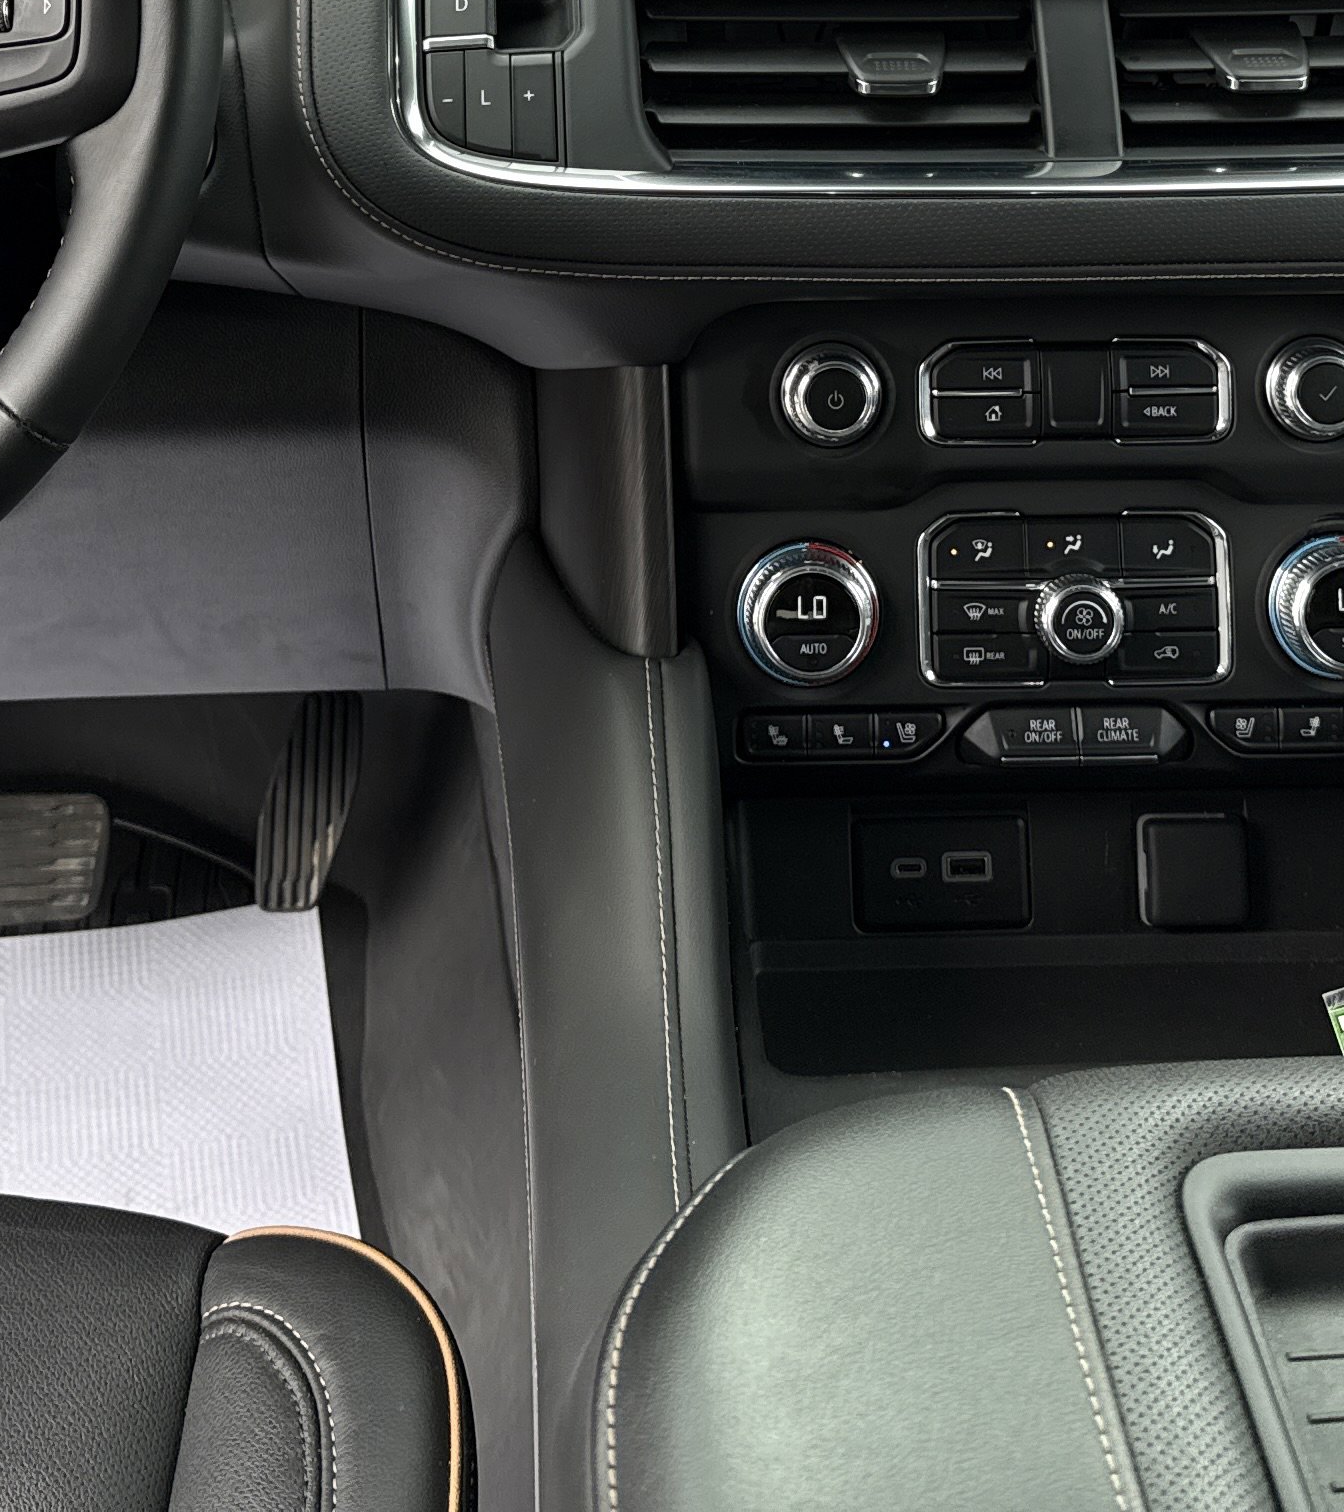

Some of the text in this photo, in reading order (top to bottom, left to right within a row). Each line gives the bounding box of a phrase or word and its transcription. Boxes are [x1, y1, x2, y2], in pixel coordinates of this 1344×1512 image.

[480, 90, 491, 106] L
[1151, 405, 1177, 418] BACK
[797, 595, 827, 619] LO
[988, 607, 1004, 616] MAX
[1159, 603, 1178, 615] A/C
[1066, 628, 1105, 640] ON/OFF
[799, 642, 827, 655] AUTO
[986, 651, 1005, 660] REAR
[1029, 719, 1056, 731] REAR
[1103, 717, 1130, 729] REAR
[1024, 731, 1062, 743] ON/OFF
[1097, 729, 1140, 742] CLIMATE
